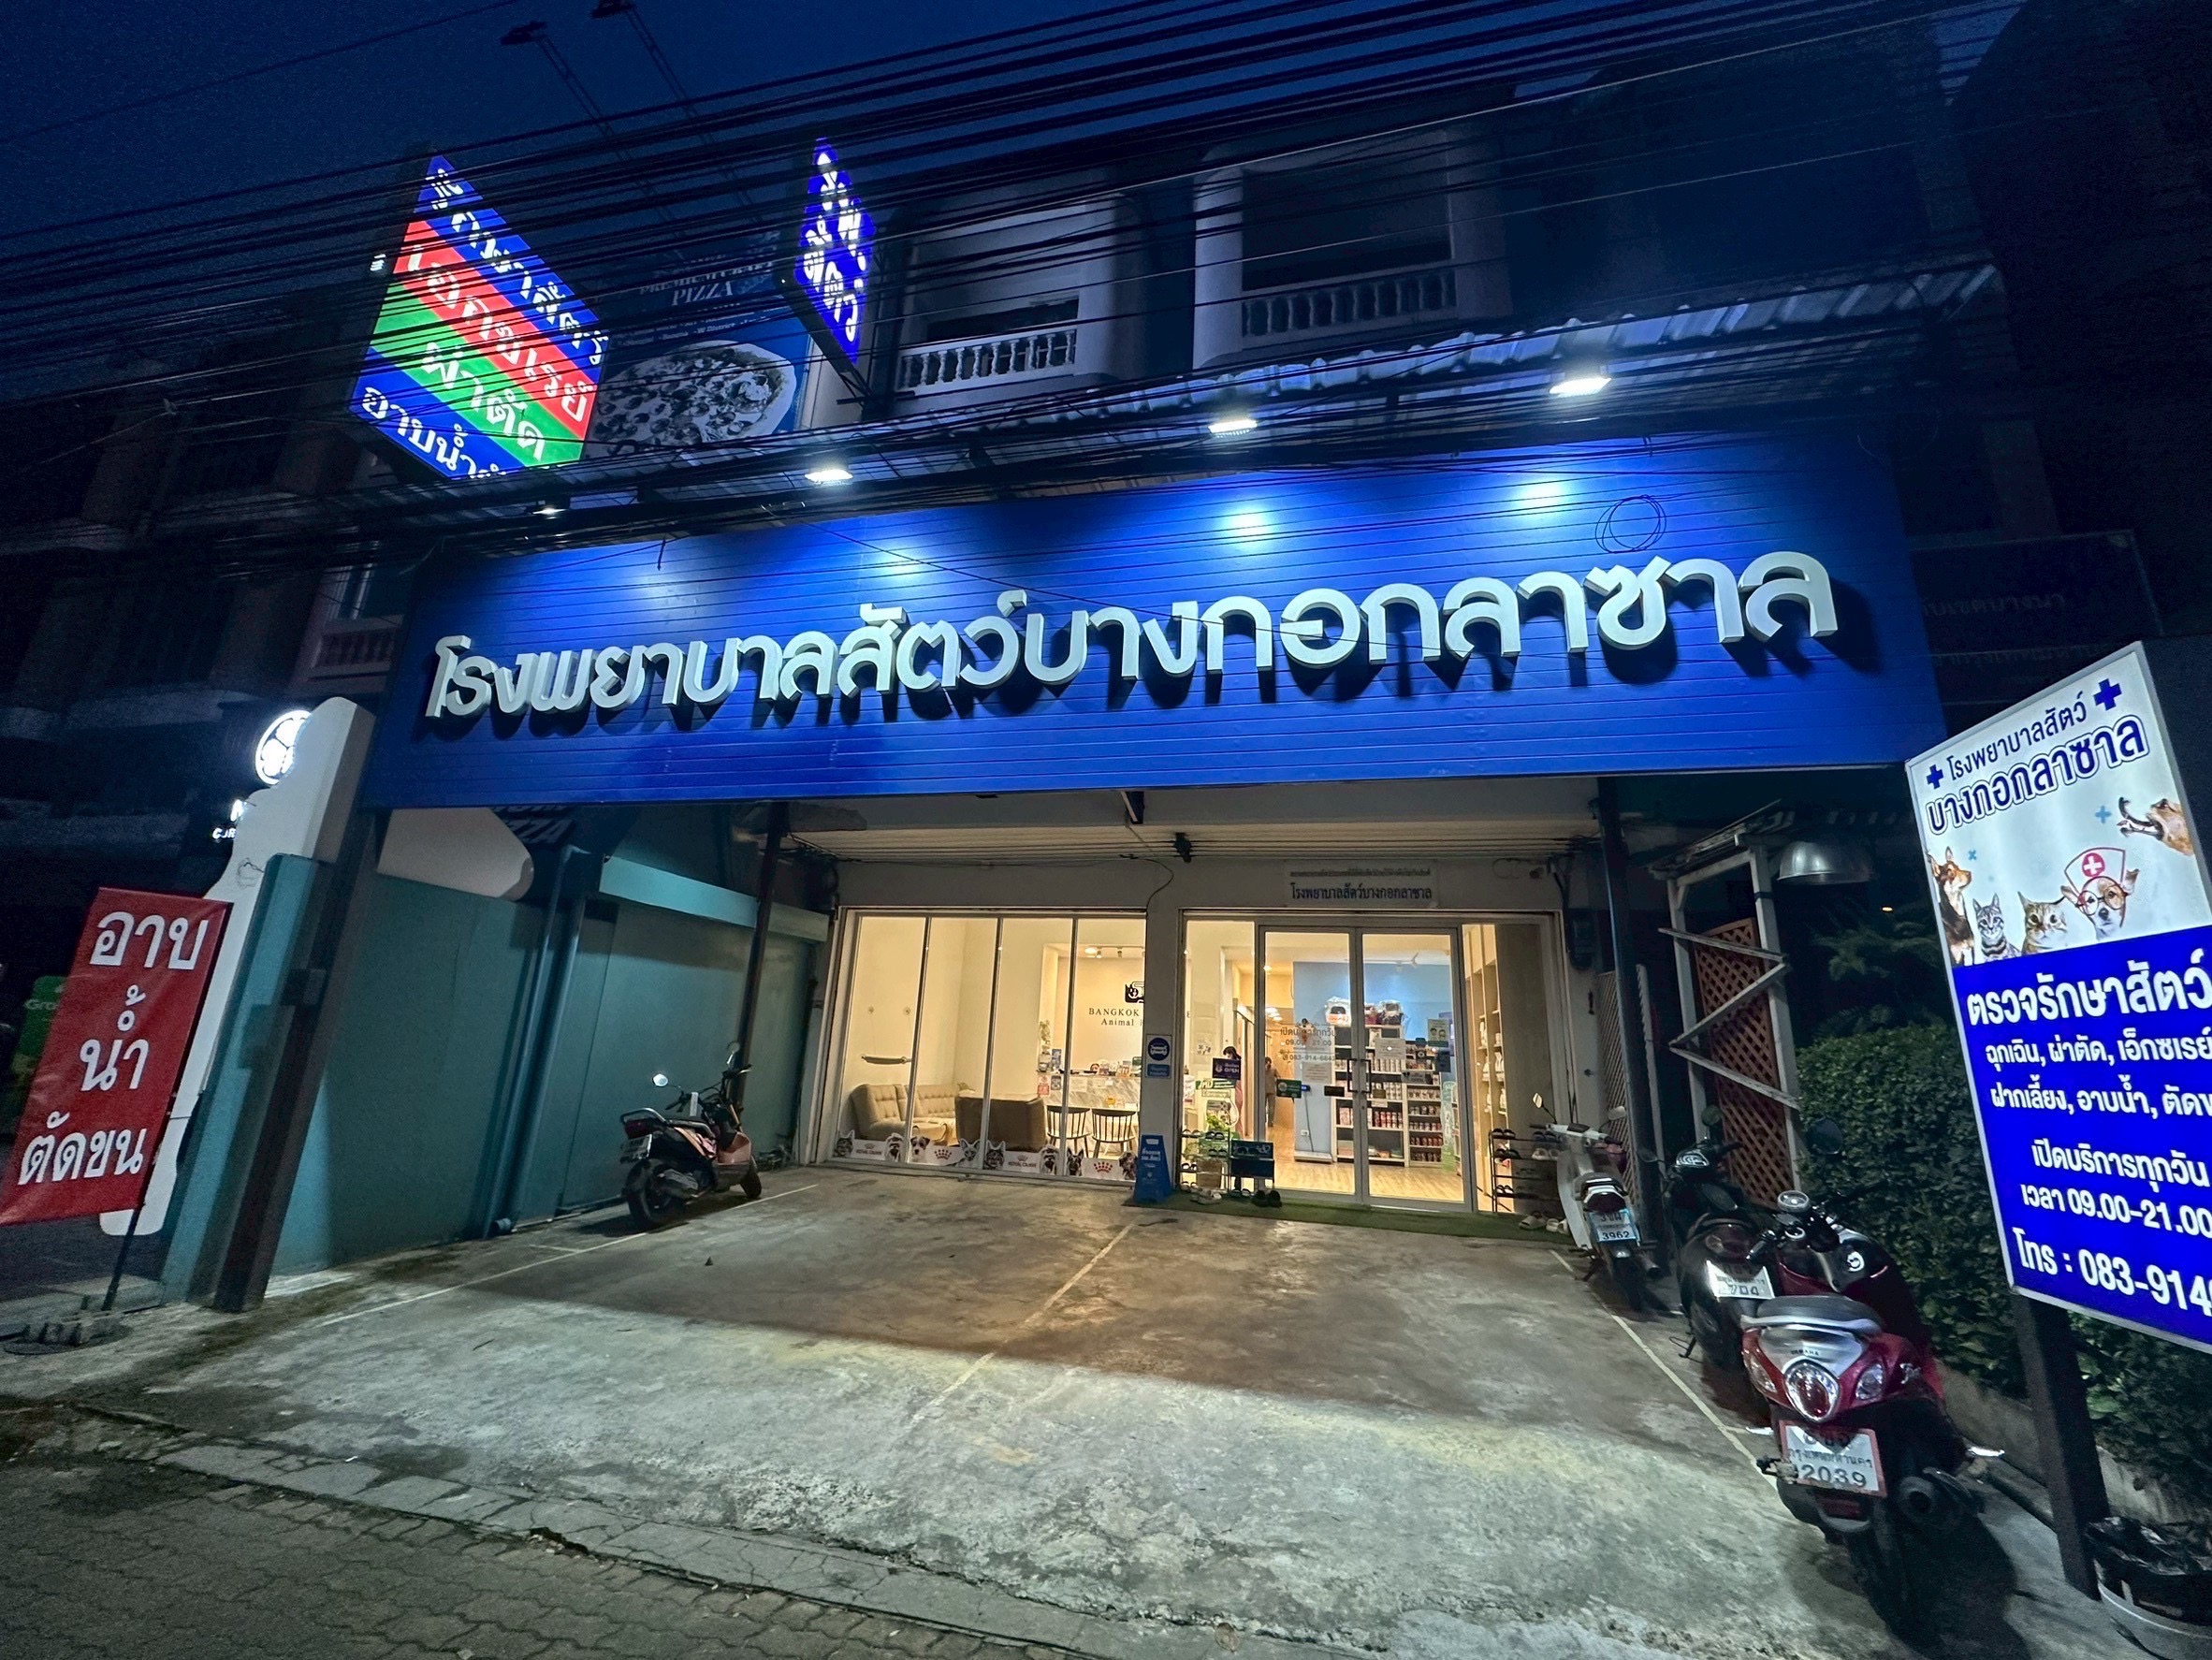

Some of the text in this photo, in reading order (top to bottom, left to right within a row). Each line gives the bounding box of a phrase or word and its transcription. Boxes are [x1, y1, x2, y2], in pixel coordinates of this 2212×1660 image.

[671, 280, 735, 307] PIZZA
[425, 550, 1838, 719] โรงพยาบาลสัตว์บางกอกลาซาล
[1947, 690, 2088, 782] โรงพยาบาลสัตว์
[1928, 717, 2148, 834] บางกอกลาซาล
[89, 910, 210, 970] อาบ
[1088, 1007, 1140, 1017] BANGKOK
[1967, 948, 2212, 1027] ตรวจรักษาสัตว์
[79, 983, 150, 1092] น้ำ
[1100, 1018, 1134, 1027] Animal
[1986, 1038, 2046, 1072] ฉุกเฉิน,
[2047, 1035, 2116, 1068] ผ่าตัด,
[2076, 1074, 2159, 1119] อาบน้ำ,
[17, 1111, 147, 1186] ตัดขน
[2031, 1138, 2211, 1193] เปิดบริการทุกวัน
[1602, 1230, 1630, 1240] 3962
[2021, 1184, 2212, 1239] เวลา 09.00-21.00
[1729, 1284, 1759, 1296] 704
[2012, 1227, 2059, 1276] โทร
[2078, 1247, 2212, 1317] 083-914
[1800, 1463, 1867, 1488] 2039
